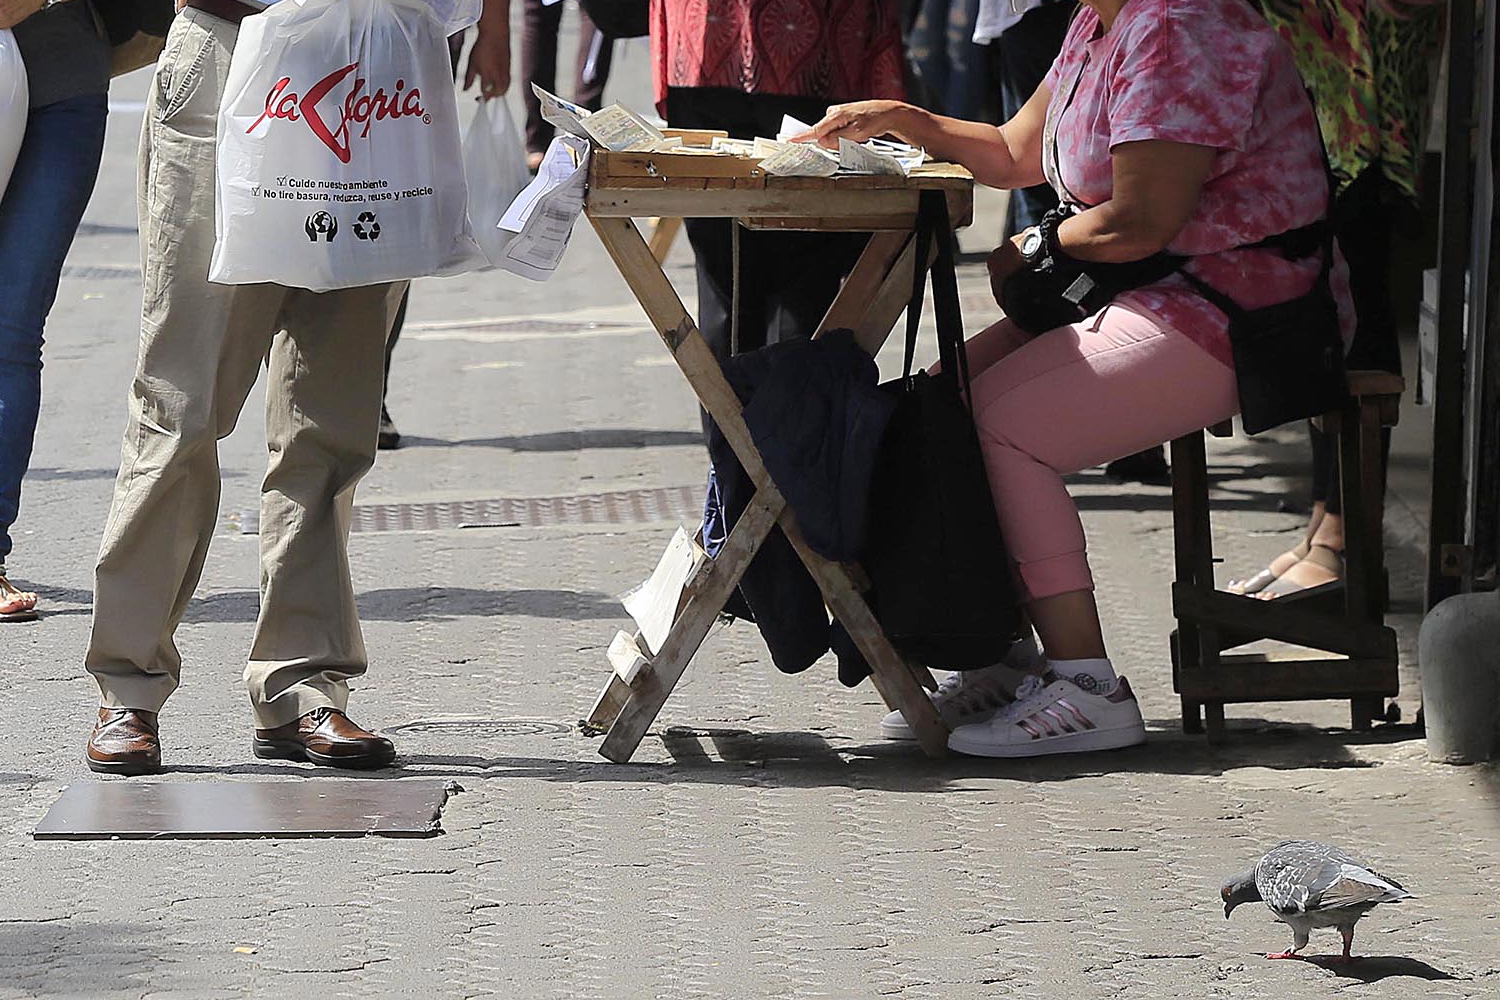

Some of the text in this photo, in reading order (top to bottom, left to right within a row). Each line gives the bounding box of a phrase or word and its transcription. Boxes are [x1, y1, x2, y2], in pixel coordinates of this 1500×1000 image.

[289, 178, 316, 189] Cuide
[348, 176, 388, 189] ambiente
[263, 189, 277, 200] No
[279, 190, 295, 200] tire
[296, 190, 332, 203] basura,
[393, 191, 401, 202] y
[402, 186, 434, 199] recicle
